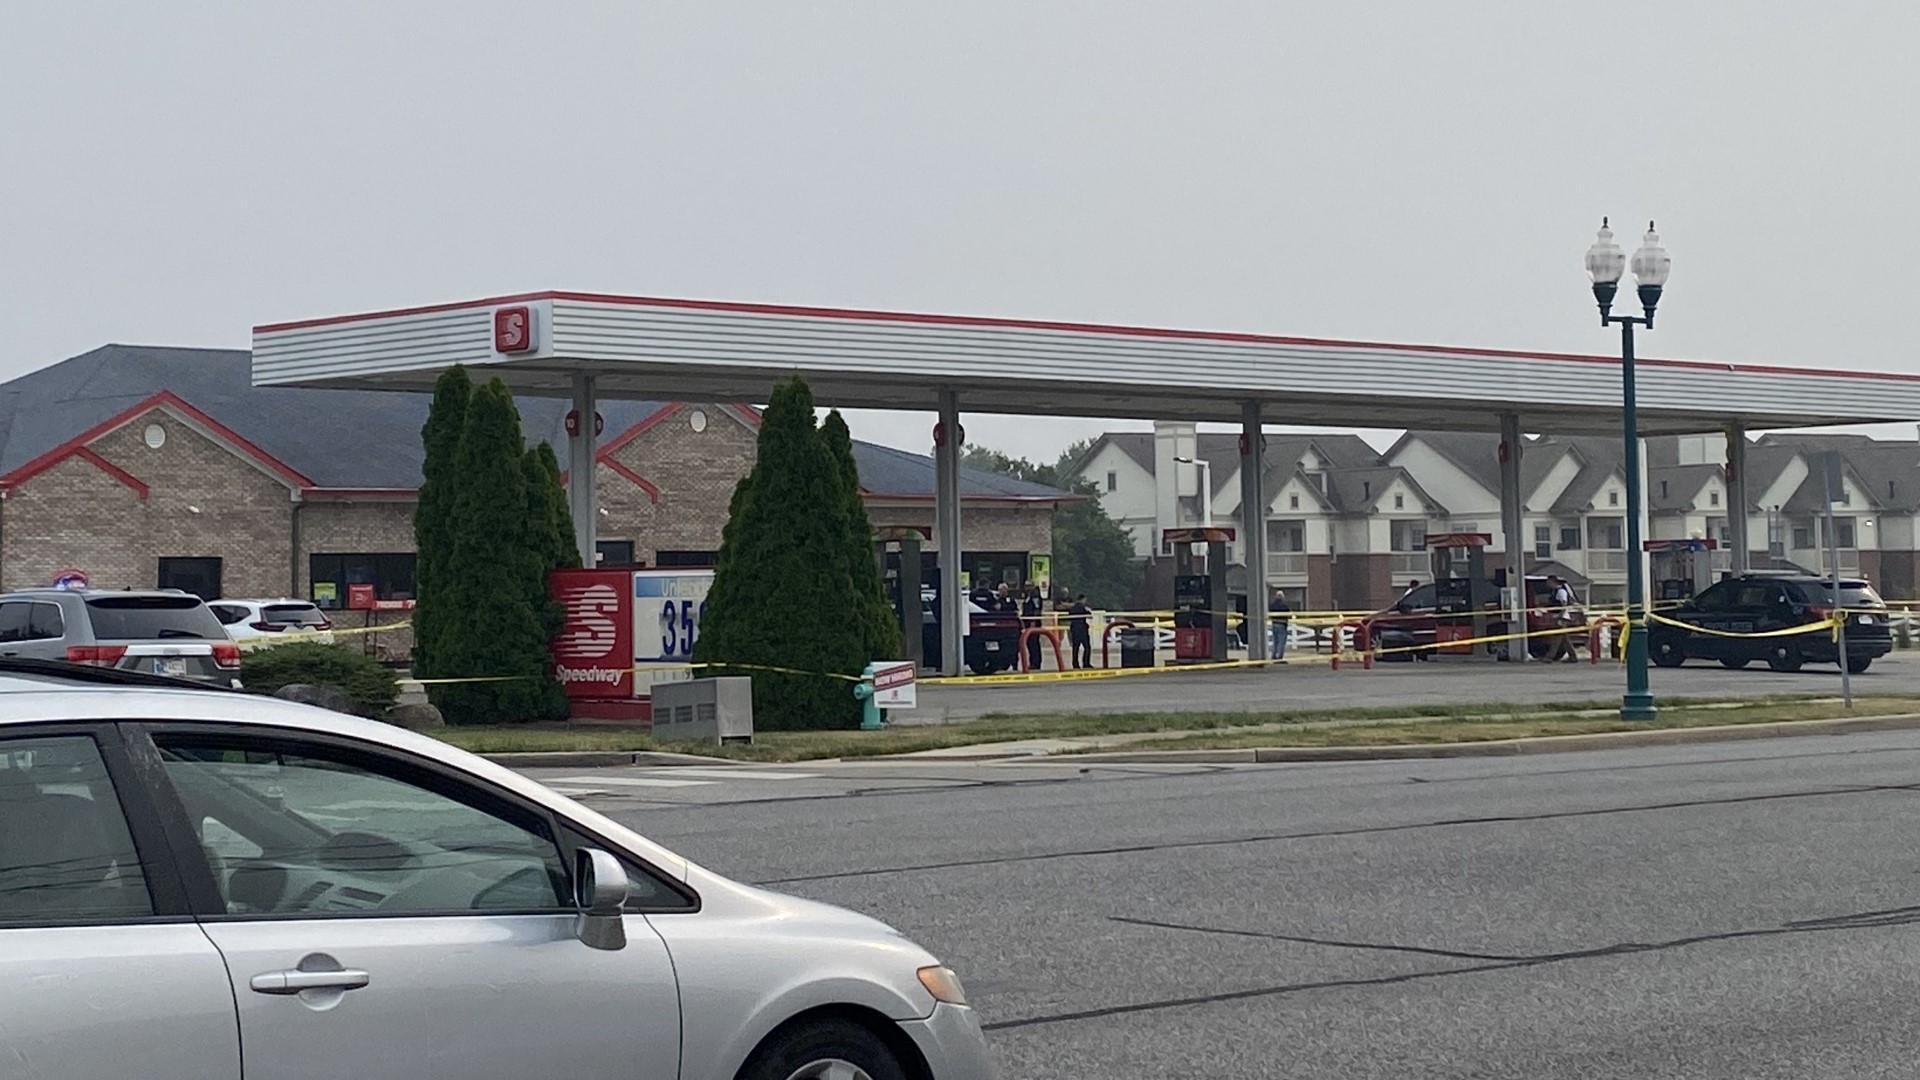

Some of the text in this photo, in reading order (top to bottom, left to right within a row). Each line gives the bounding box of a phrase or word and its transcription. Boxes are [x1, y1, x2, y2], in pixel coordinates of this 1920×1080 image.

[499, 313, 524, 346] S
[556, 584, 618, 657] S
[555, 664, 623, 686] Speedway
